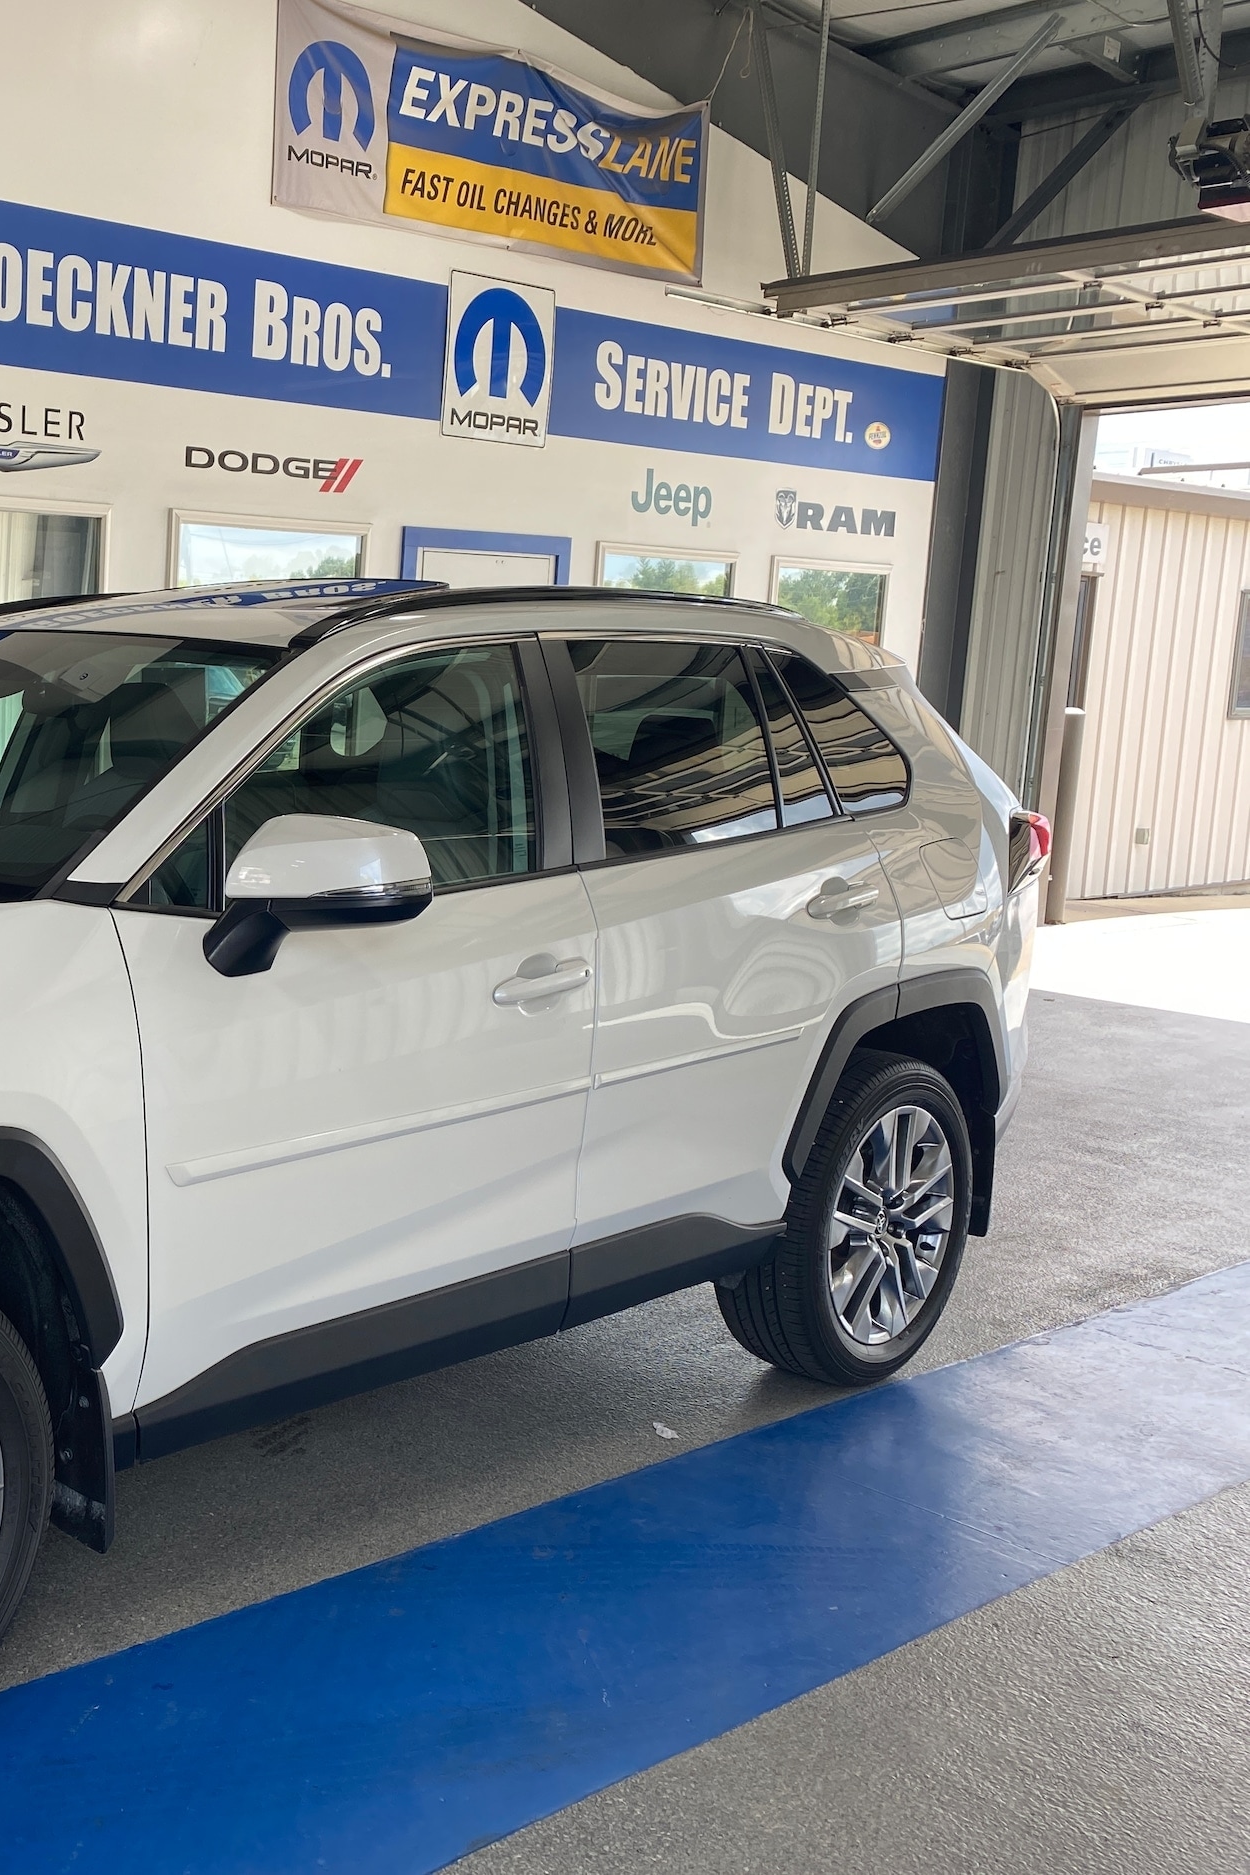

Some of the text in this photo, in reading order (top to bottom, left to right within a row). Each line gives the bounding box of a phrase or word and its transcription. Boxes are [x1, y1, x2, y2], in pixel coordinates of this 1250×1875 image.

[400, 167, 454, 201] FAST
[456, 180, 487, 211] OIL
[493, 188, 581, 231] CHANGES
[584, 209, 599, 236] &
[251, 278, 393, 379] BROS.
[449, 406, 540, 438] MOPAR
[594, 340, 854, 445] SERVICE DEPT.
[185, 445, 341, 481] DODGE
[631, 467, 712, 527] Jeep
[796, 501, 896, 537] RAM
